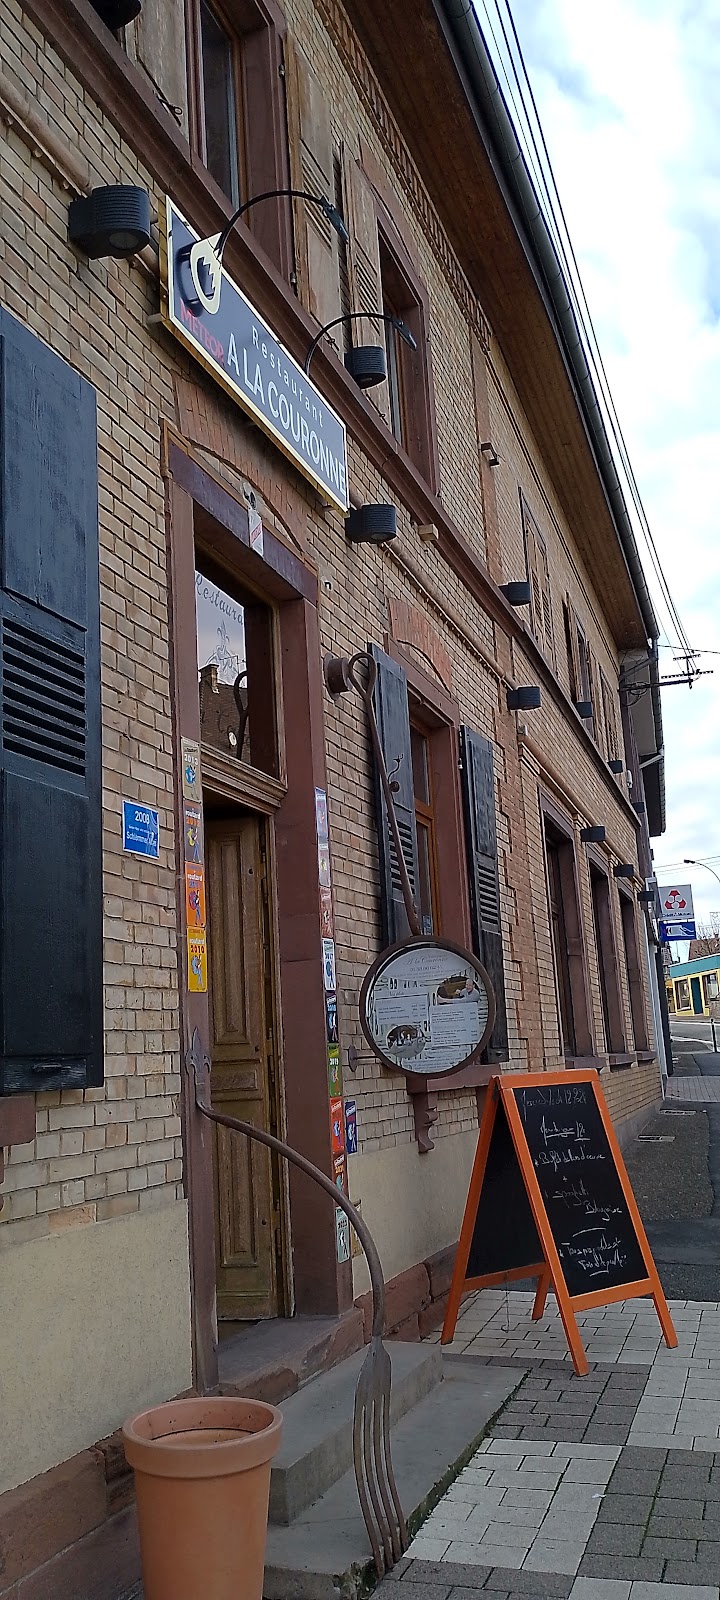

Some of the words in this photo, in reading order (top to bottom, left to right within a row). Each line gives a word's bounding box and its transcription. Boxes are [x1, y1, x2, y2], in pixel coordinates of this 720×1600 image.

[180, 297, 225, 367] METEOR
[252, 325, 324, 428] Restaurant
[227, 332, 240, 376] A
[243, 348, 266, 406] LA
[267, 381, 347, 496] COURONNE
[134, 810, 150, 825] 2008
[190, 944, 205, 955] 2010
